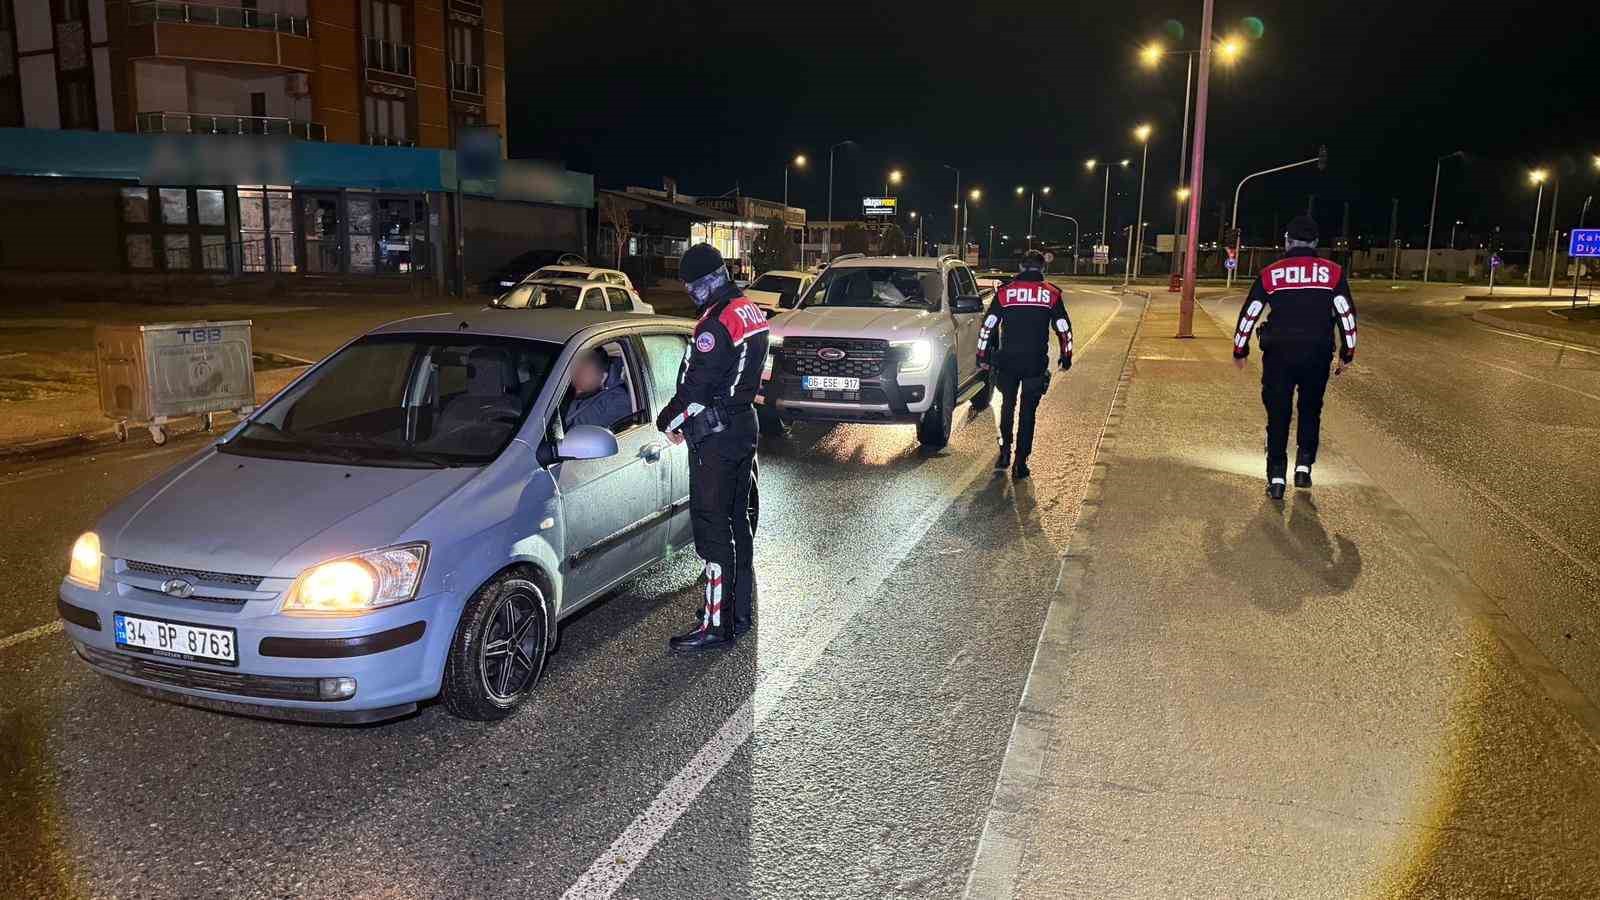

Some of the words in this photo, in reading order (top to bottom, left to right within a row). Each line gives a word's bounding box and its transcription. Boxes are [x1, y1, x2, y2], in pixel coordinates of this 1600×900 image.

[1270, 262, 1330, 286] POLİS
[1006, 286, 1050, 303] POLİS
[176, 328, 222, 343] TBB
[127, 621, 146, 645] 34
[158, 625, 177, 649] BP
[188, 631, 231, 657] 8763
